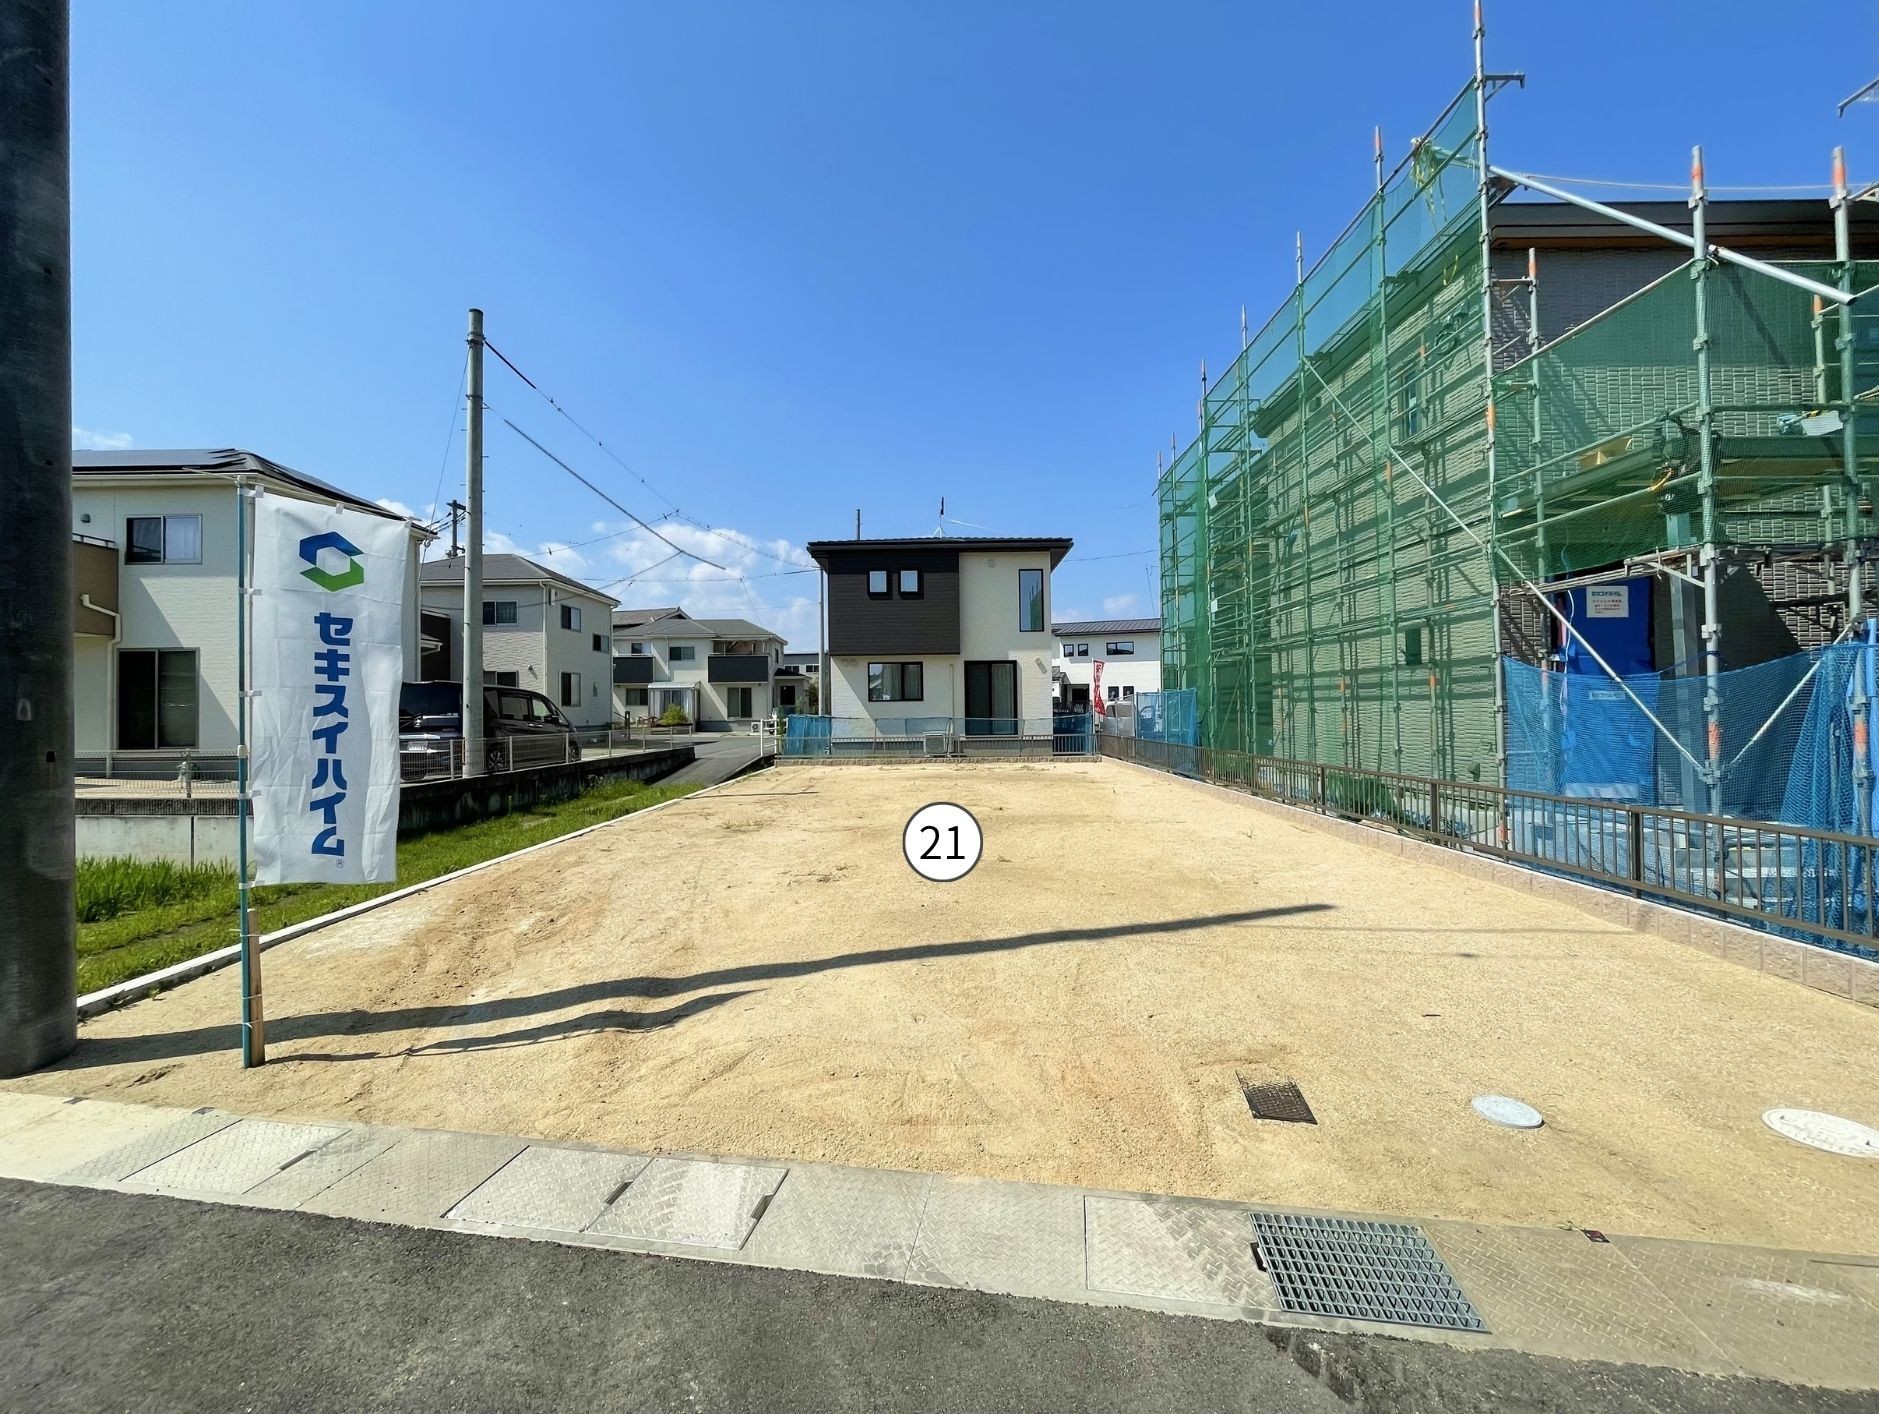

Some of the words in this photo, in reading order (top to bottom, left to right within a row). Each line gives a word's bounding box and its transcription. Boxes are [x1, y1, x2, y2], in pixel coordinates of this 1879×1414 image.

[310, 612, 353, 857] セキスイハイム
